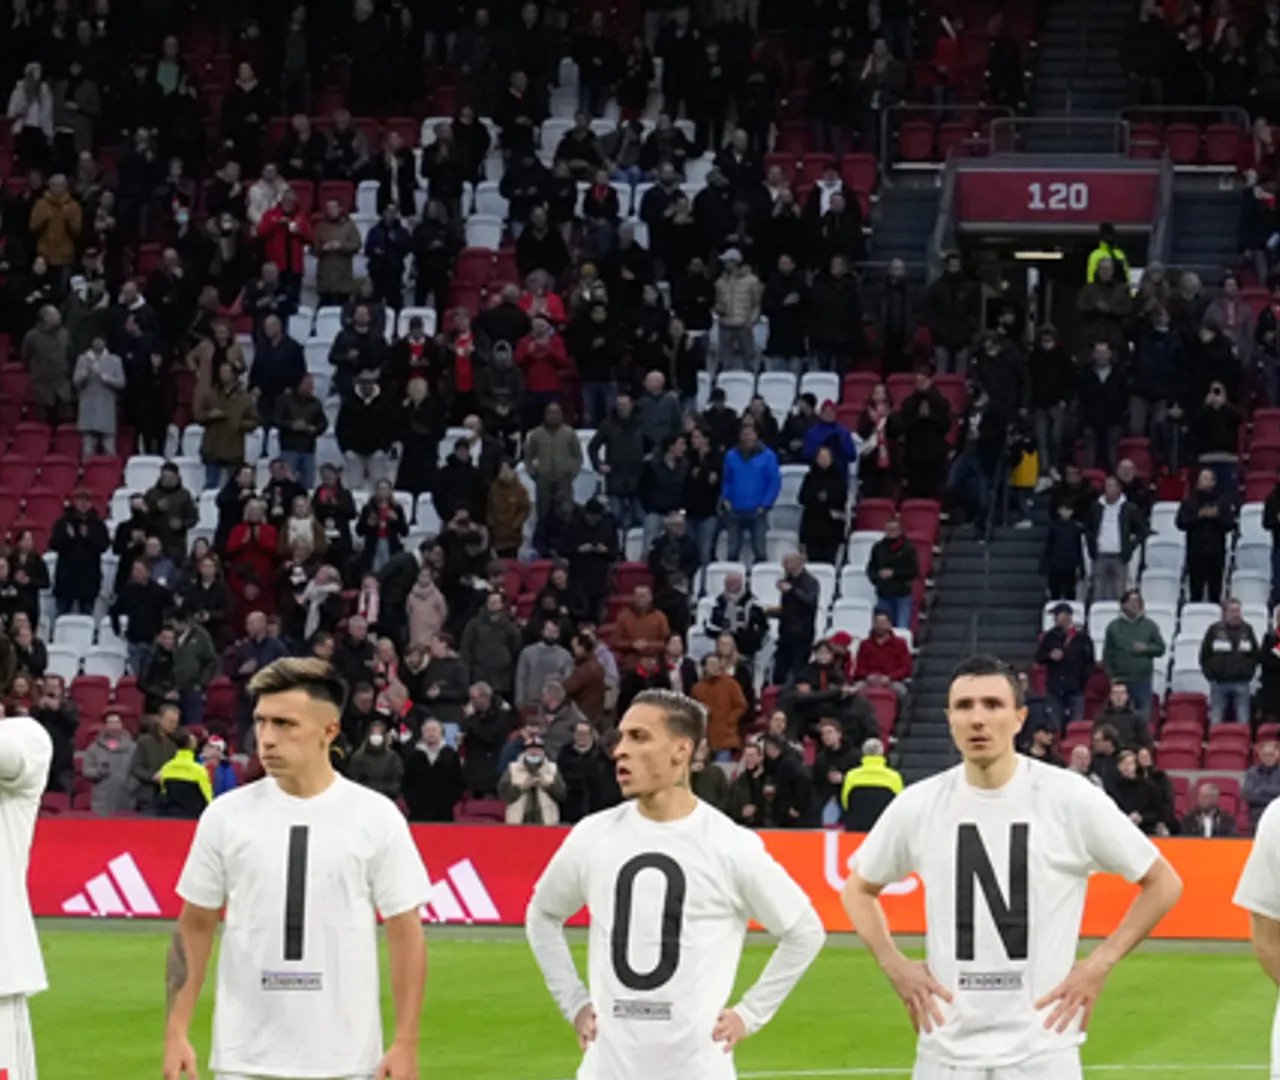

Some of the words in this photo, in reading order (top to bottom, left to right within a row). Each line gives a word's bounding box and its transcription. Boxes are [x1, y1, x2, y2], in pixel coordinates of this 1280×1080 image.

[1027, 182, 1089, 210] 120
[283, 825, 309, 961] I
[955, 823, 1029, 961] N
